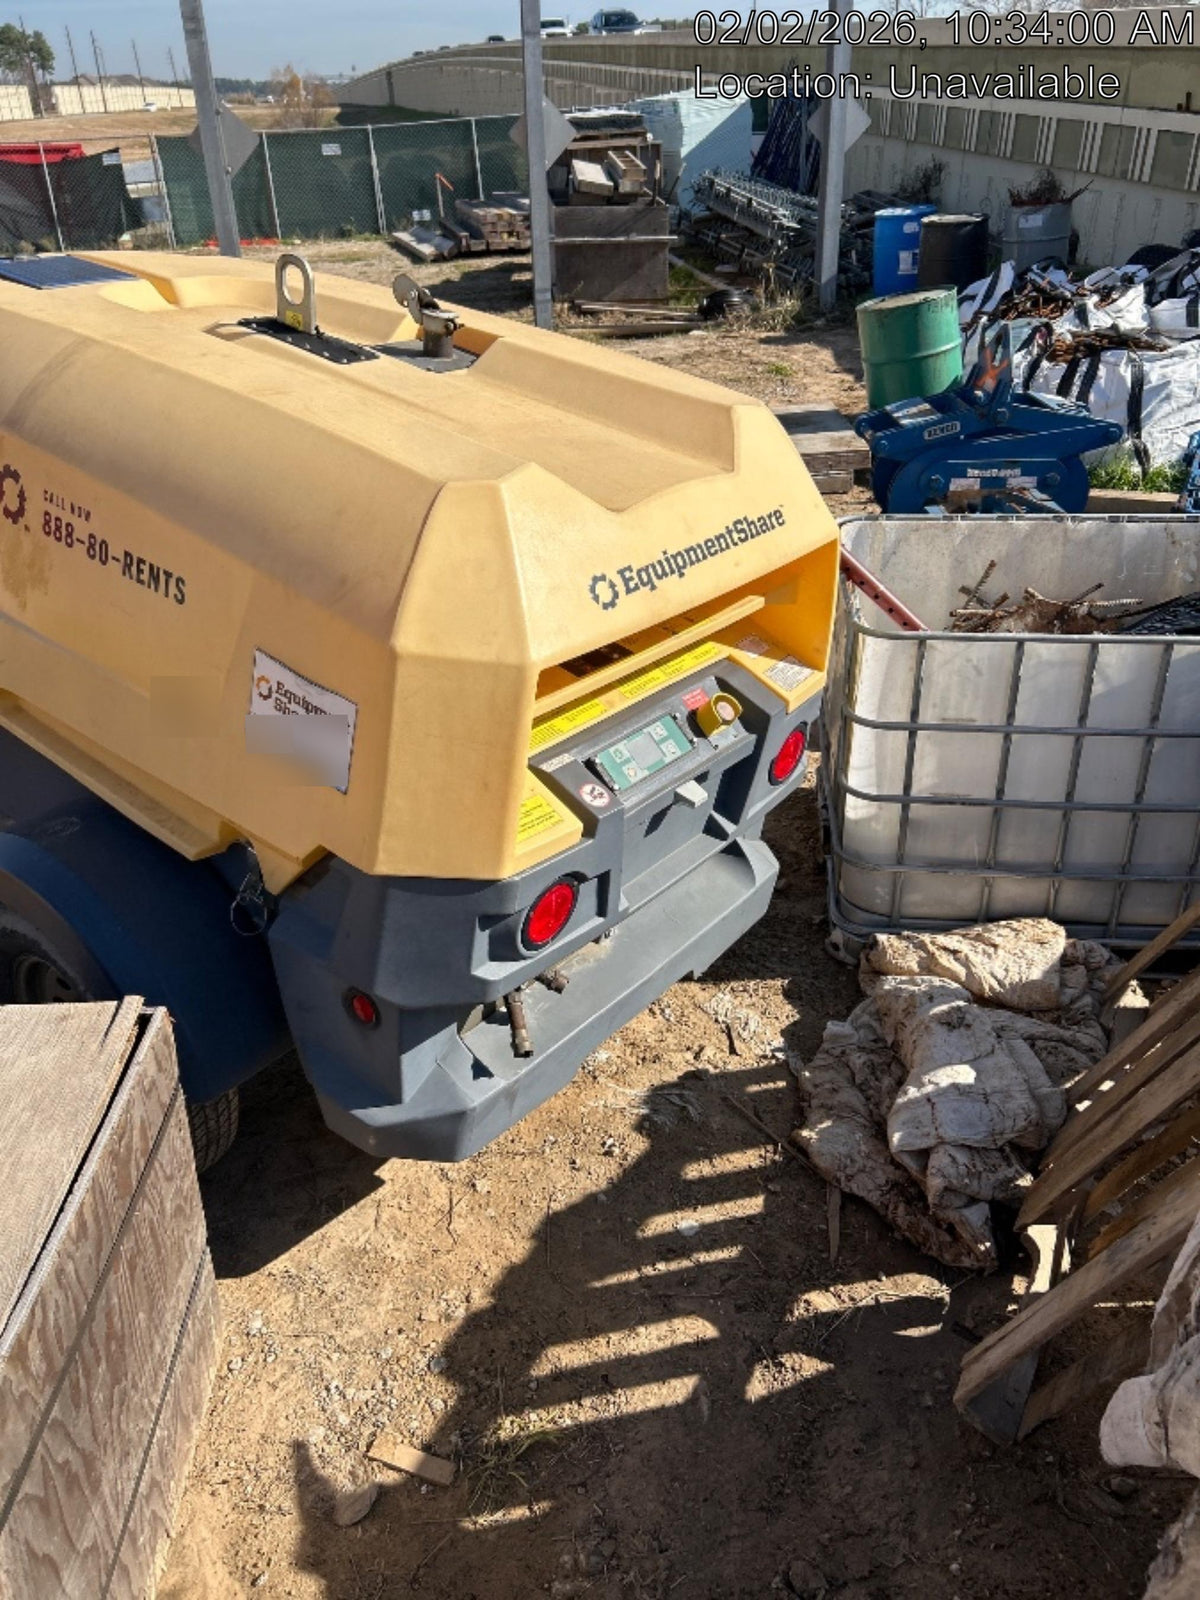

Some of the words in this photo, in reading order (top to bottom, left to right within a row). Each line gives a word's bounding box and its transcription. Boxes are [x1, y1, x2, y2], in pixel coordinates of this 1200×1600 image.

[43, 489, 66, 511] CALL
[42, 510, 187, 606] 888-80-RENTS
[617, 507, 786, 596] EquipmentShare
